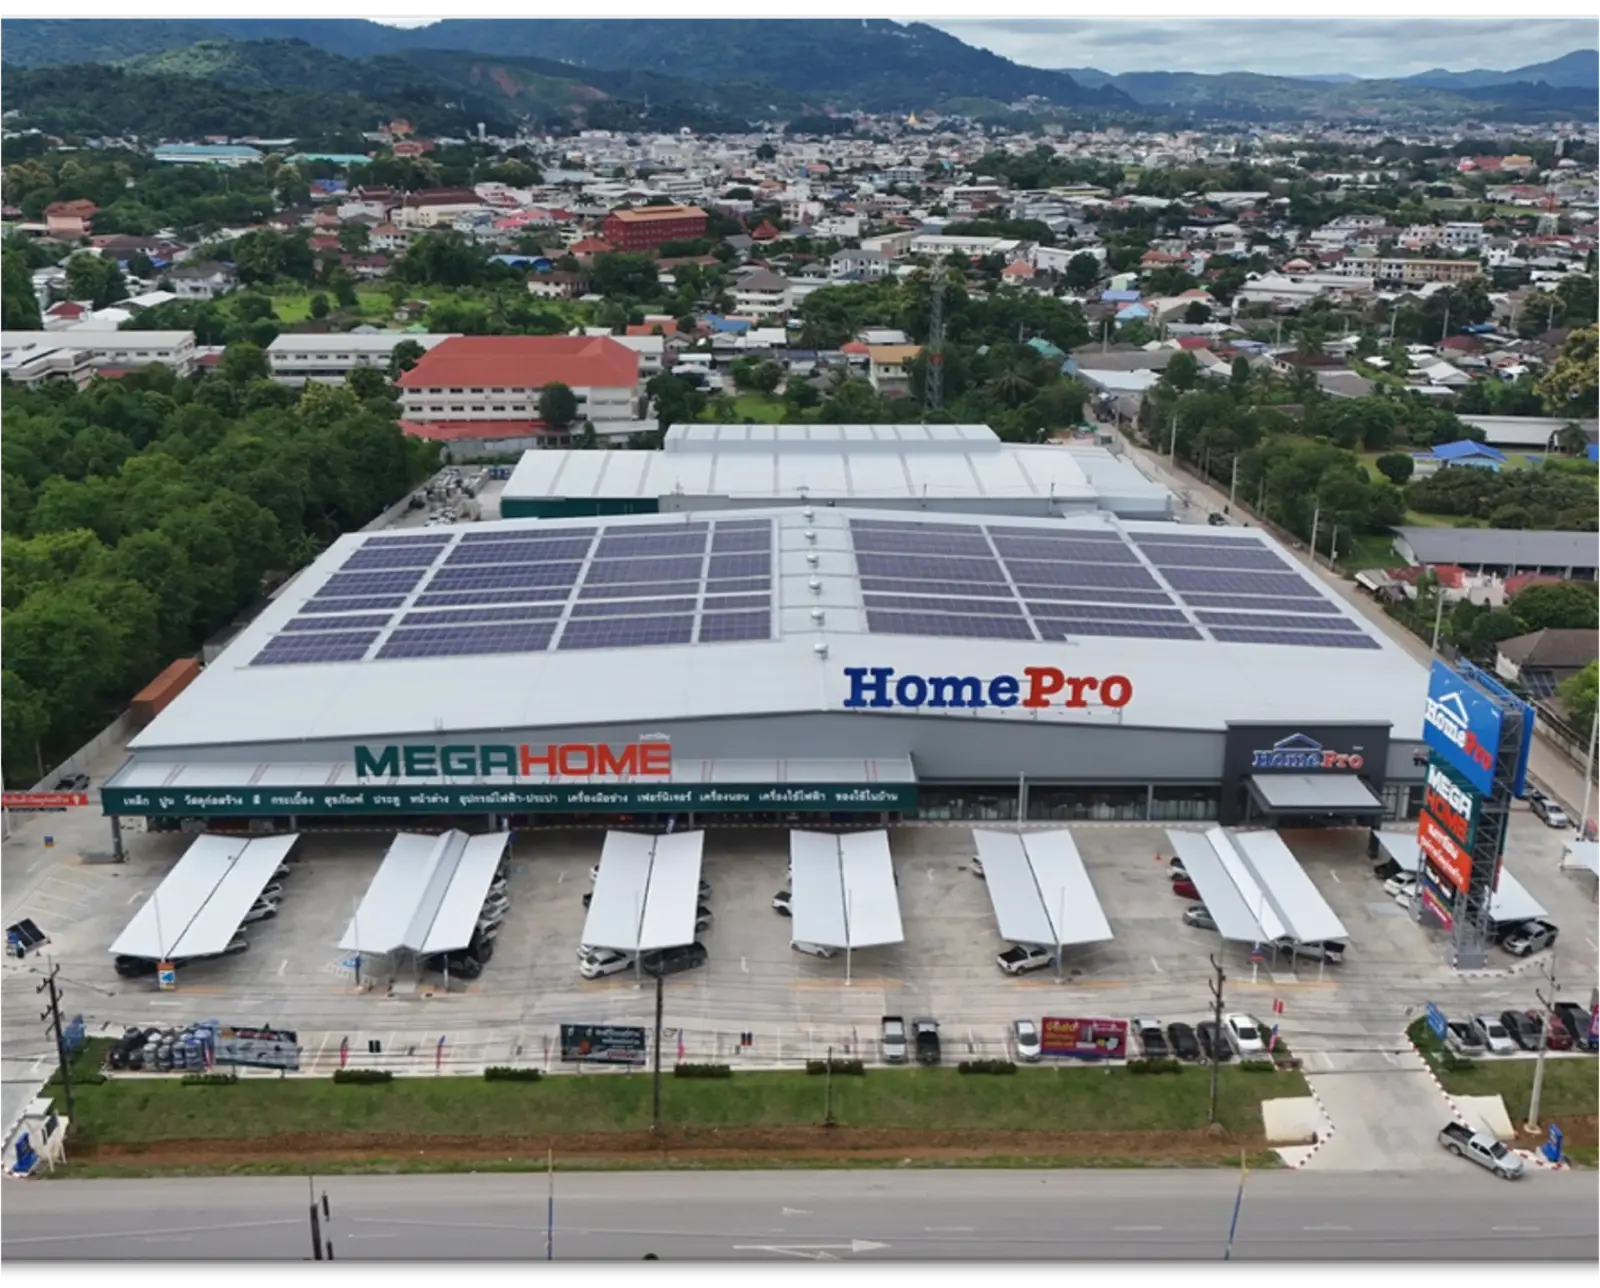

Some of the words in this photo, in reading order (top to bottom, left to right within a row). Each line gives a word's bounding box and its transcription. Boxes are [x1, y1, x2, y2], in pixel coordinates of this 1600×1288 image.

[843, 666, 1133, 708] HomePro
[1251, 749, 1364, 769] HomePro
[1428, 763, 1473, 821] MEGA
